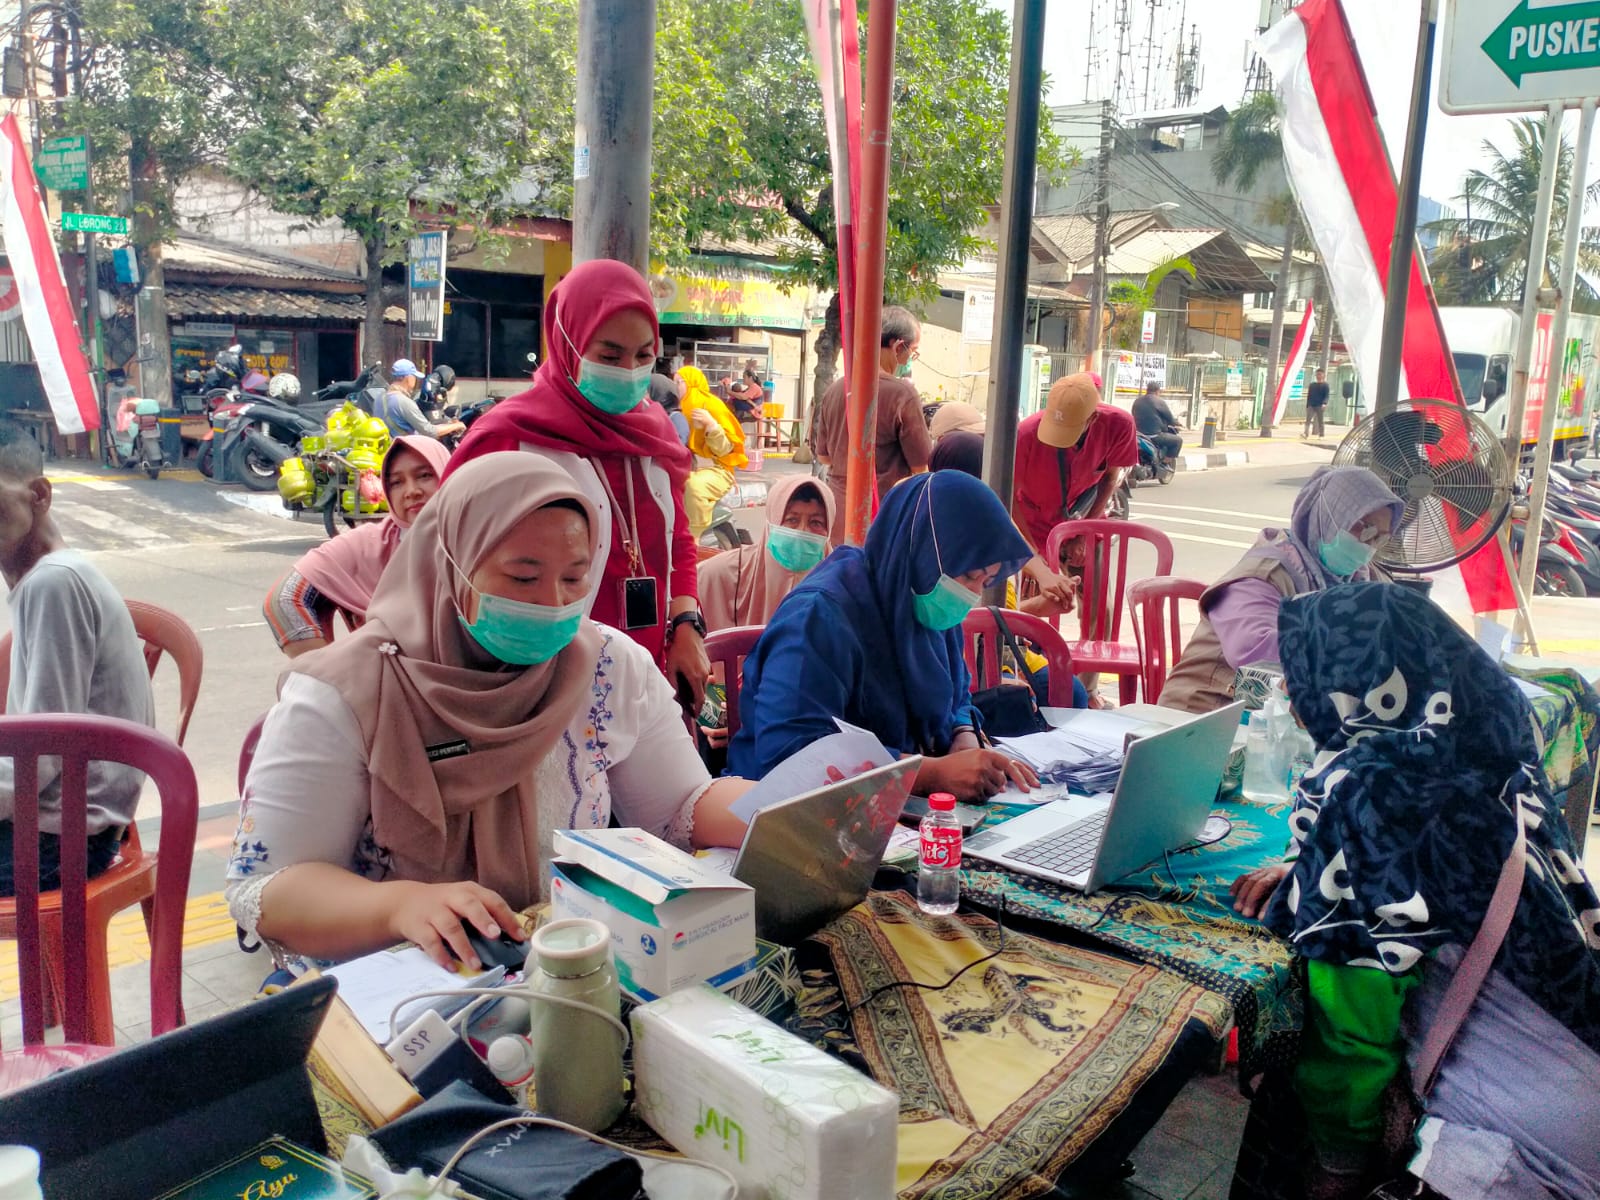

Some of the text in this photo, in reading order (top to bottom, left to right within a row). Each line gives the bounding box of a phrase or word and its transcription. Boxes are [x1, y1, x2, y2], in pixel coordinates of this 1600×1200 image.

[1509, 18, 1600, 60] PUSKE
[78, 216, 113, 231] LORONG
[1055, 410, 1064, 421] R
[718, 918, 734, 930] FACE
[403, 1029, 431, 1057] SSP
[234, 1172, 299, 1200] Ayu
